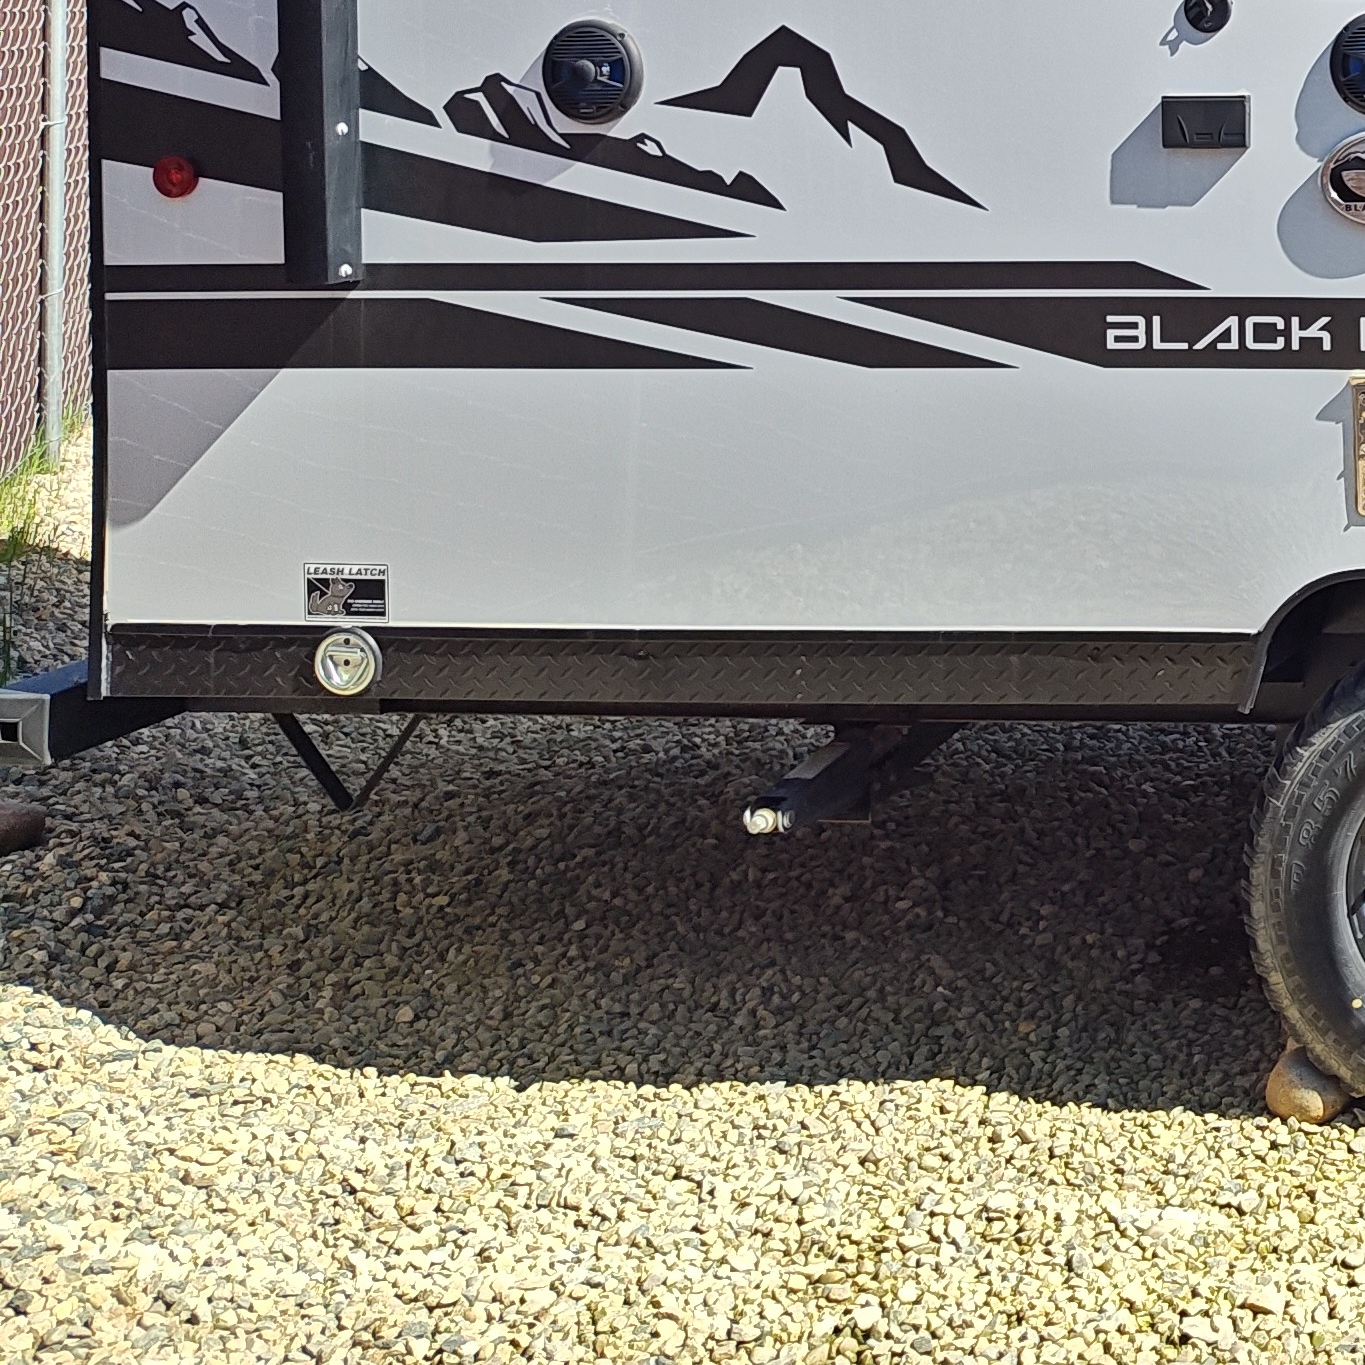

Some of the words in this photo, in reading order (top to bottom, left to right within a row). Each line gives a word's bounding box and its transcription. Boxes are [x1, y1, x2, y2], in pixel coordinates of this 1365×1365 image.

[1106, 315, 1332, 351] BLACK
[307, 567, 345, 576] LEASH
[347, 567, 387, 577] LATCH
